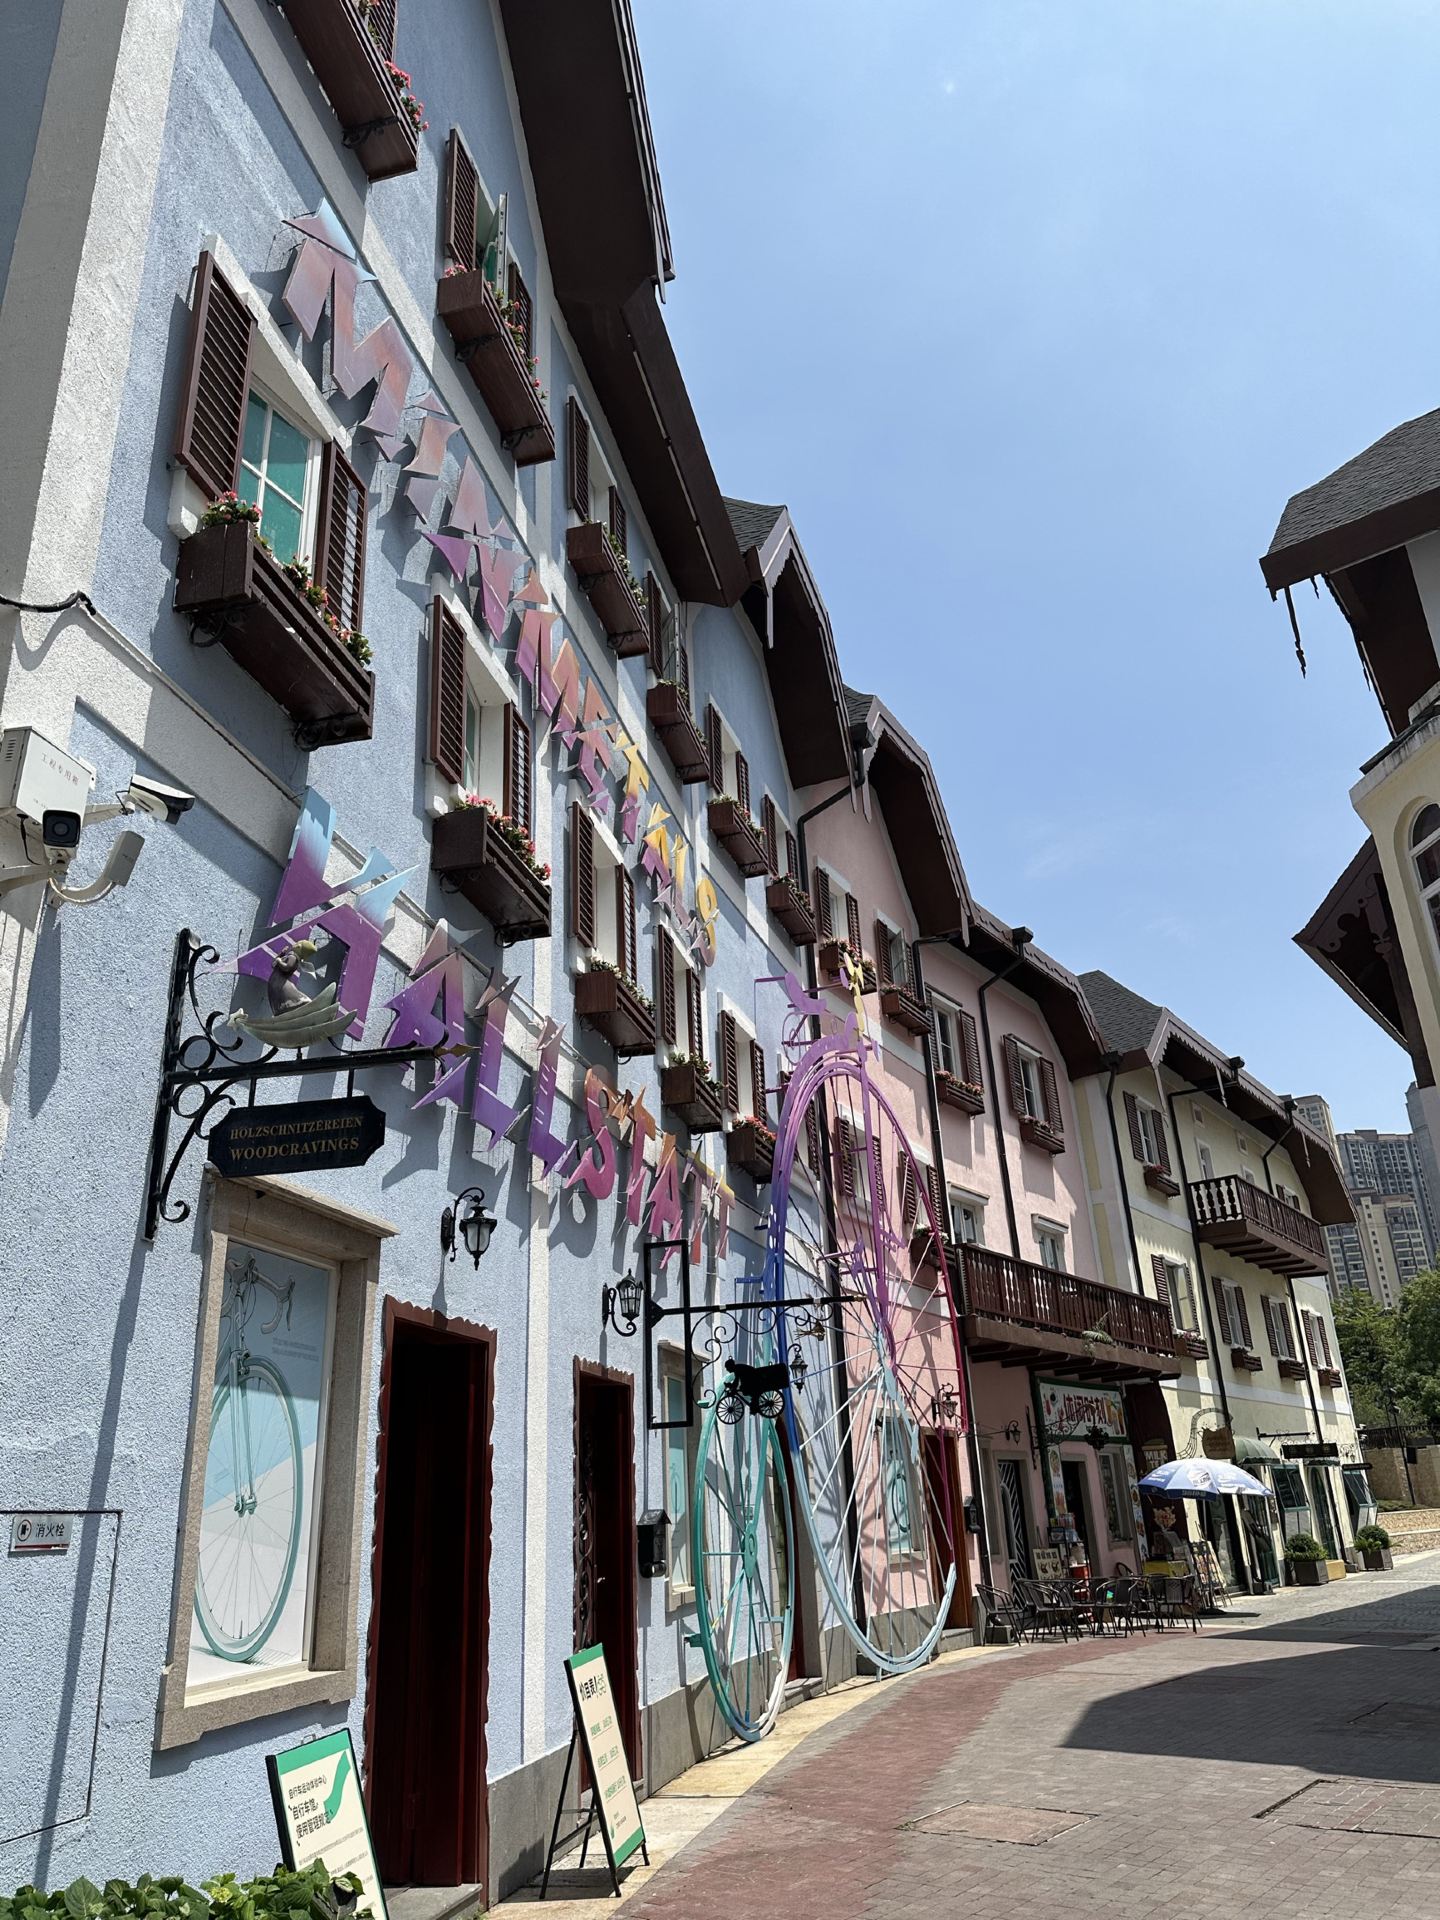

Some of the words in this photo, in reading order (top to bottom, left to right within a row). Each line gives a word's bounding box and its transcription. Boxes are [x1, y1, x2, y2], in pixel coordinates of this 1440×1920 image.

[282, 197, 720, 968] MINMETALS
[209, 786, 736, 1269] HALLSTATT
[230, 1116, 364, 1140] HOLZSCHNITZEREIEN
[229, 1137, 361, 1162] WOODCRAVINGS
[1144, 1450, 1169, 1462] MILK
[36, 1523, 65, 1538] 消火栓
